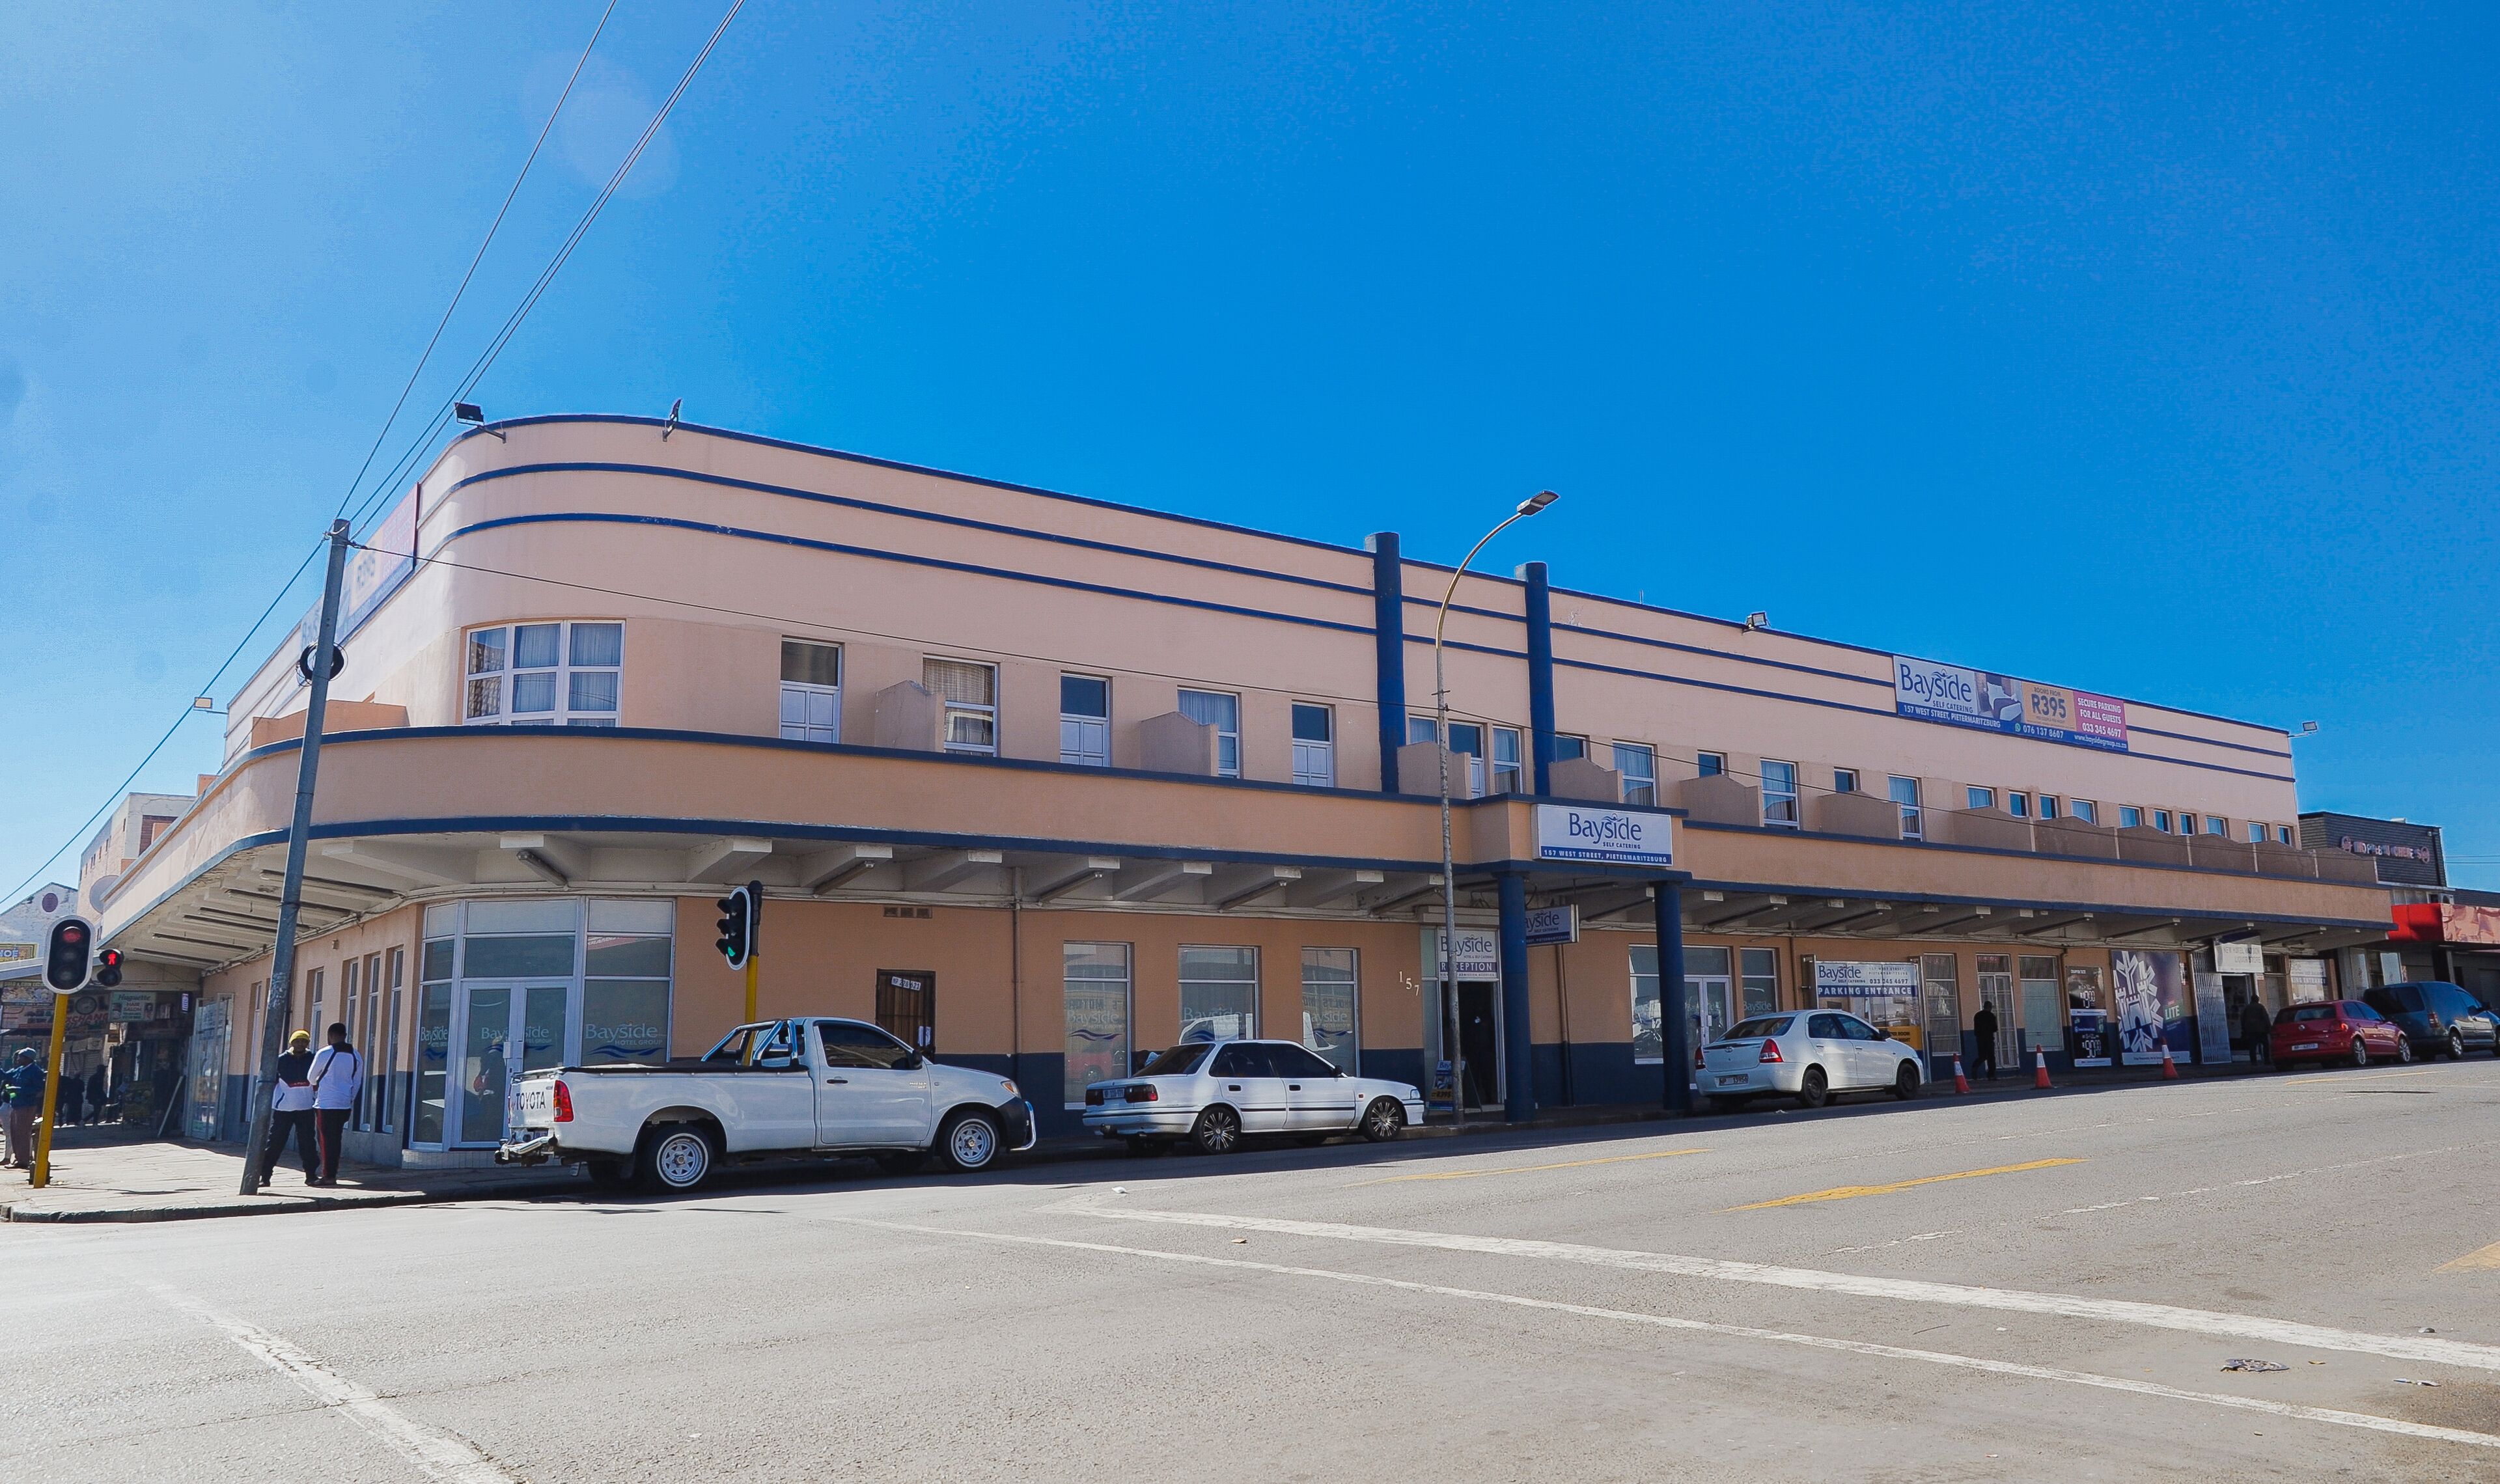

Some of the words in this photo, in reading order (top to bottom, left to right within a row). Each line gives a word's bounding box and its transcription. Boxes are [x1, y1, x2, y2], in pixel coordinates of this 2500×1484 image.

[1900, 664, 1971, 702] Bayside
[2034, 687, 2049, 695] ROOMS
[1946, 703, 1973, 713] CATERING
[2031, 693, 2066, 719] R395
[2077, 698, 2097, 709] SECURE
[2098, 702, 2121, 713] PARKING
[1915, 707, 1930, 715] WEST
[1951, 713, 2001, 728] PIETERMARITZBURG
[2080, 709, 2091, 718] FOR
[2102, 713, 2121, 724] GUESTS
[2023, 725, 2034, 734] 076
[2037, 728, 2047, 736] 137
[2049, 729, 2064, 739] 8607
[2082, 722, 2094, 732] 033
[2095, 724, 2105, 735] 345
[2107, 727, 2121, 737] 4697
[1569, 813, 1641, 844] Bayside
[1606, 853, 1667, 862] PIETERMARITZBURG
[1525, 911, 1559, 932] yside
[1440, 936, 1492, 956] Byside
[1818, 965, 1861, 982] Bayside
[1399, 970, 1419, 996] 157
[1818, 987, 1861, 995] PARKING
[1865, 987, 1911, 995] ENTRANCE
[66, 1013, 108, 1024] XCHANG
[1066, 1010, 1118, 1026] Bayside
[1312, 1011, 1347, 1026] ayside
[2165, 1005, 2180, 1020] LITE
[421, 1026, 447, 1043] Bayside
[480, 1026, 549, 1043] Bayide
[585, 1023, 658, 1043] Bayside
[516, 1092, 546, 1110] TOYOTA
